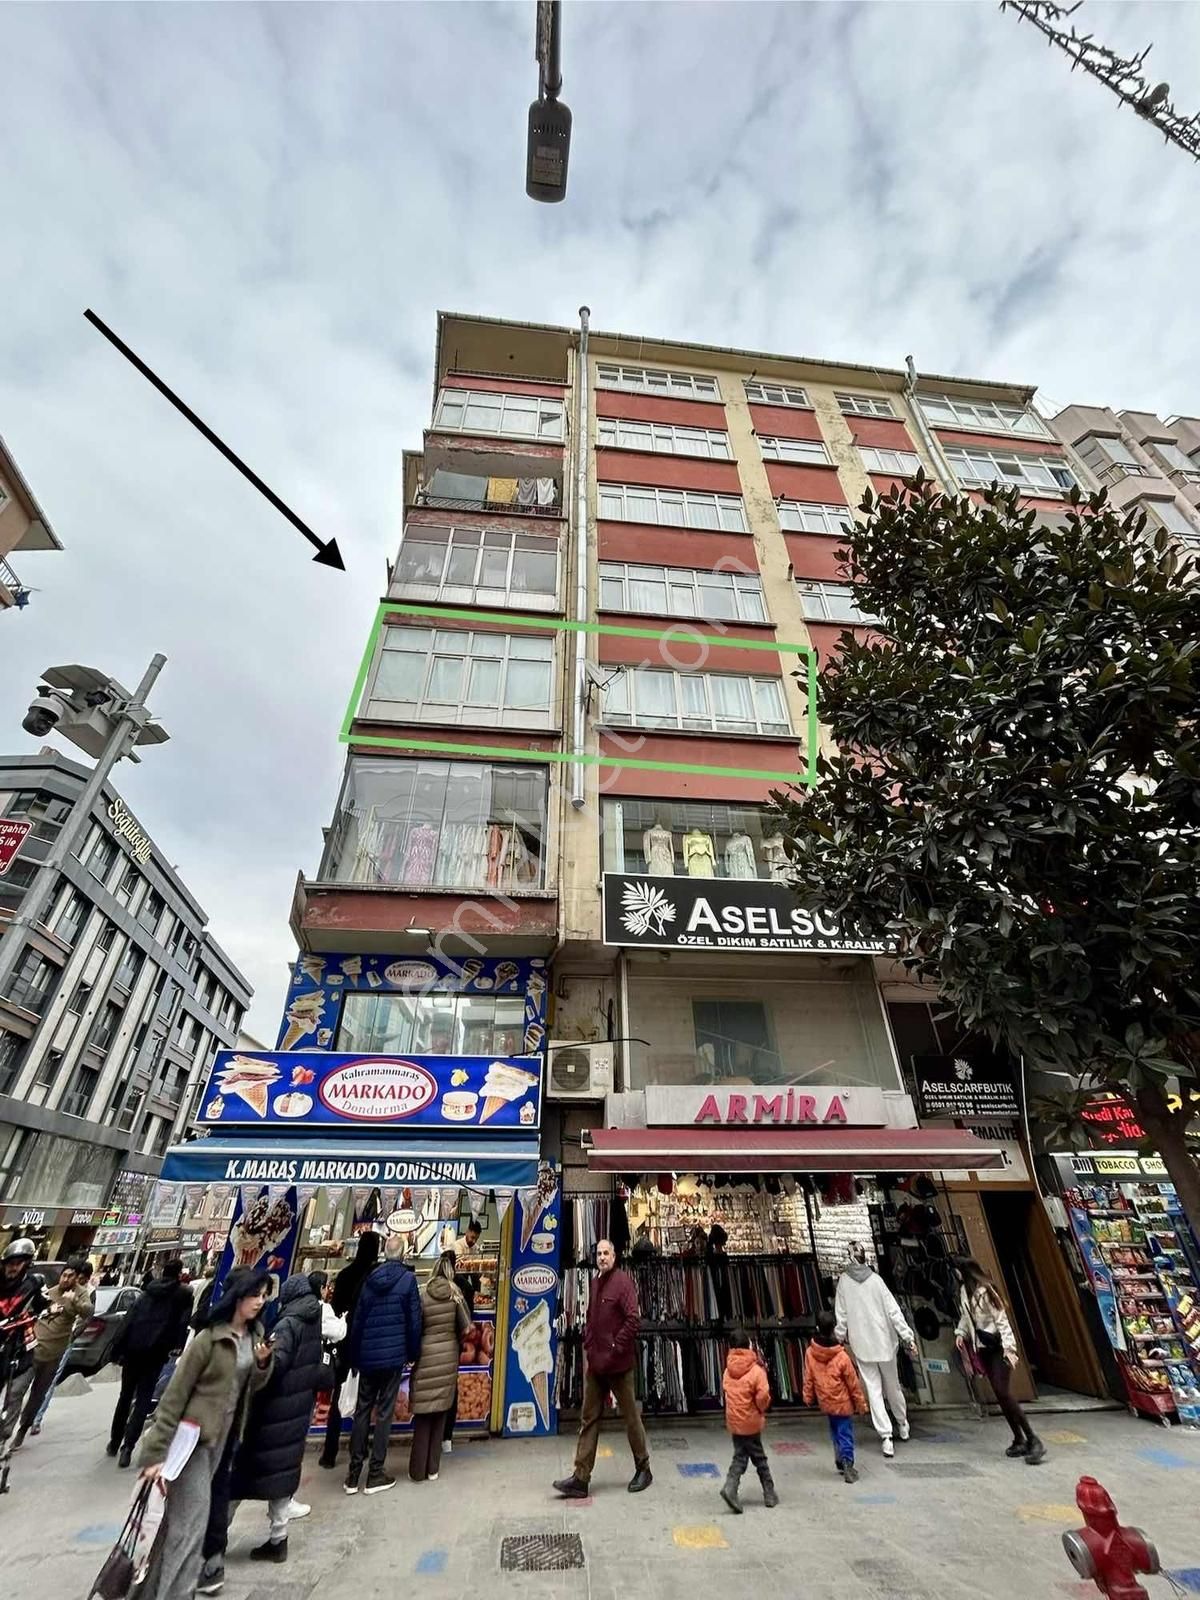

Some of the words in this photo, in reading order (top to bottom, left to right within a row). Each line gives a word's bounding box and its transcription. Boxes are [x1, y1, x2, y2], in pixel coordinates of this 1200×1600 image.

[677, 934, 714, 946] ÖZEL
[760, 938, 813, 950] SATILIK
[817, 939, 828, 950] &
[341, 1067, 420, 1083] Kahramanmaraş
[328, 1083, 426, 1101] MARKADO
[341, 1099, 408, 1115] Dondurma
[694, 1088, 848, 1123] ARMİRA
[225, 1159, 296, 1183] K.MARAŞ
[300, 1160, 378, 1180] MARKADO
[383, 1162, 477, 1182] DONDURMA
[1096, 1160, 1136, 1170] TOBACCO
[1145, 1161, 1163, 1170] SHO
[516, 1276, 554, 1285] MARKADO
